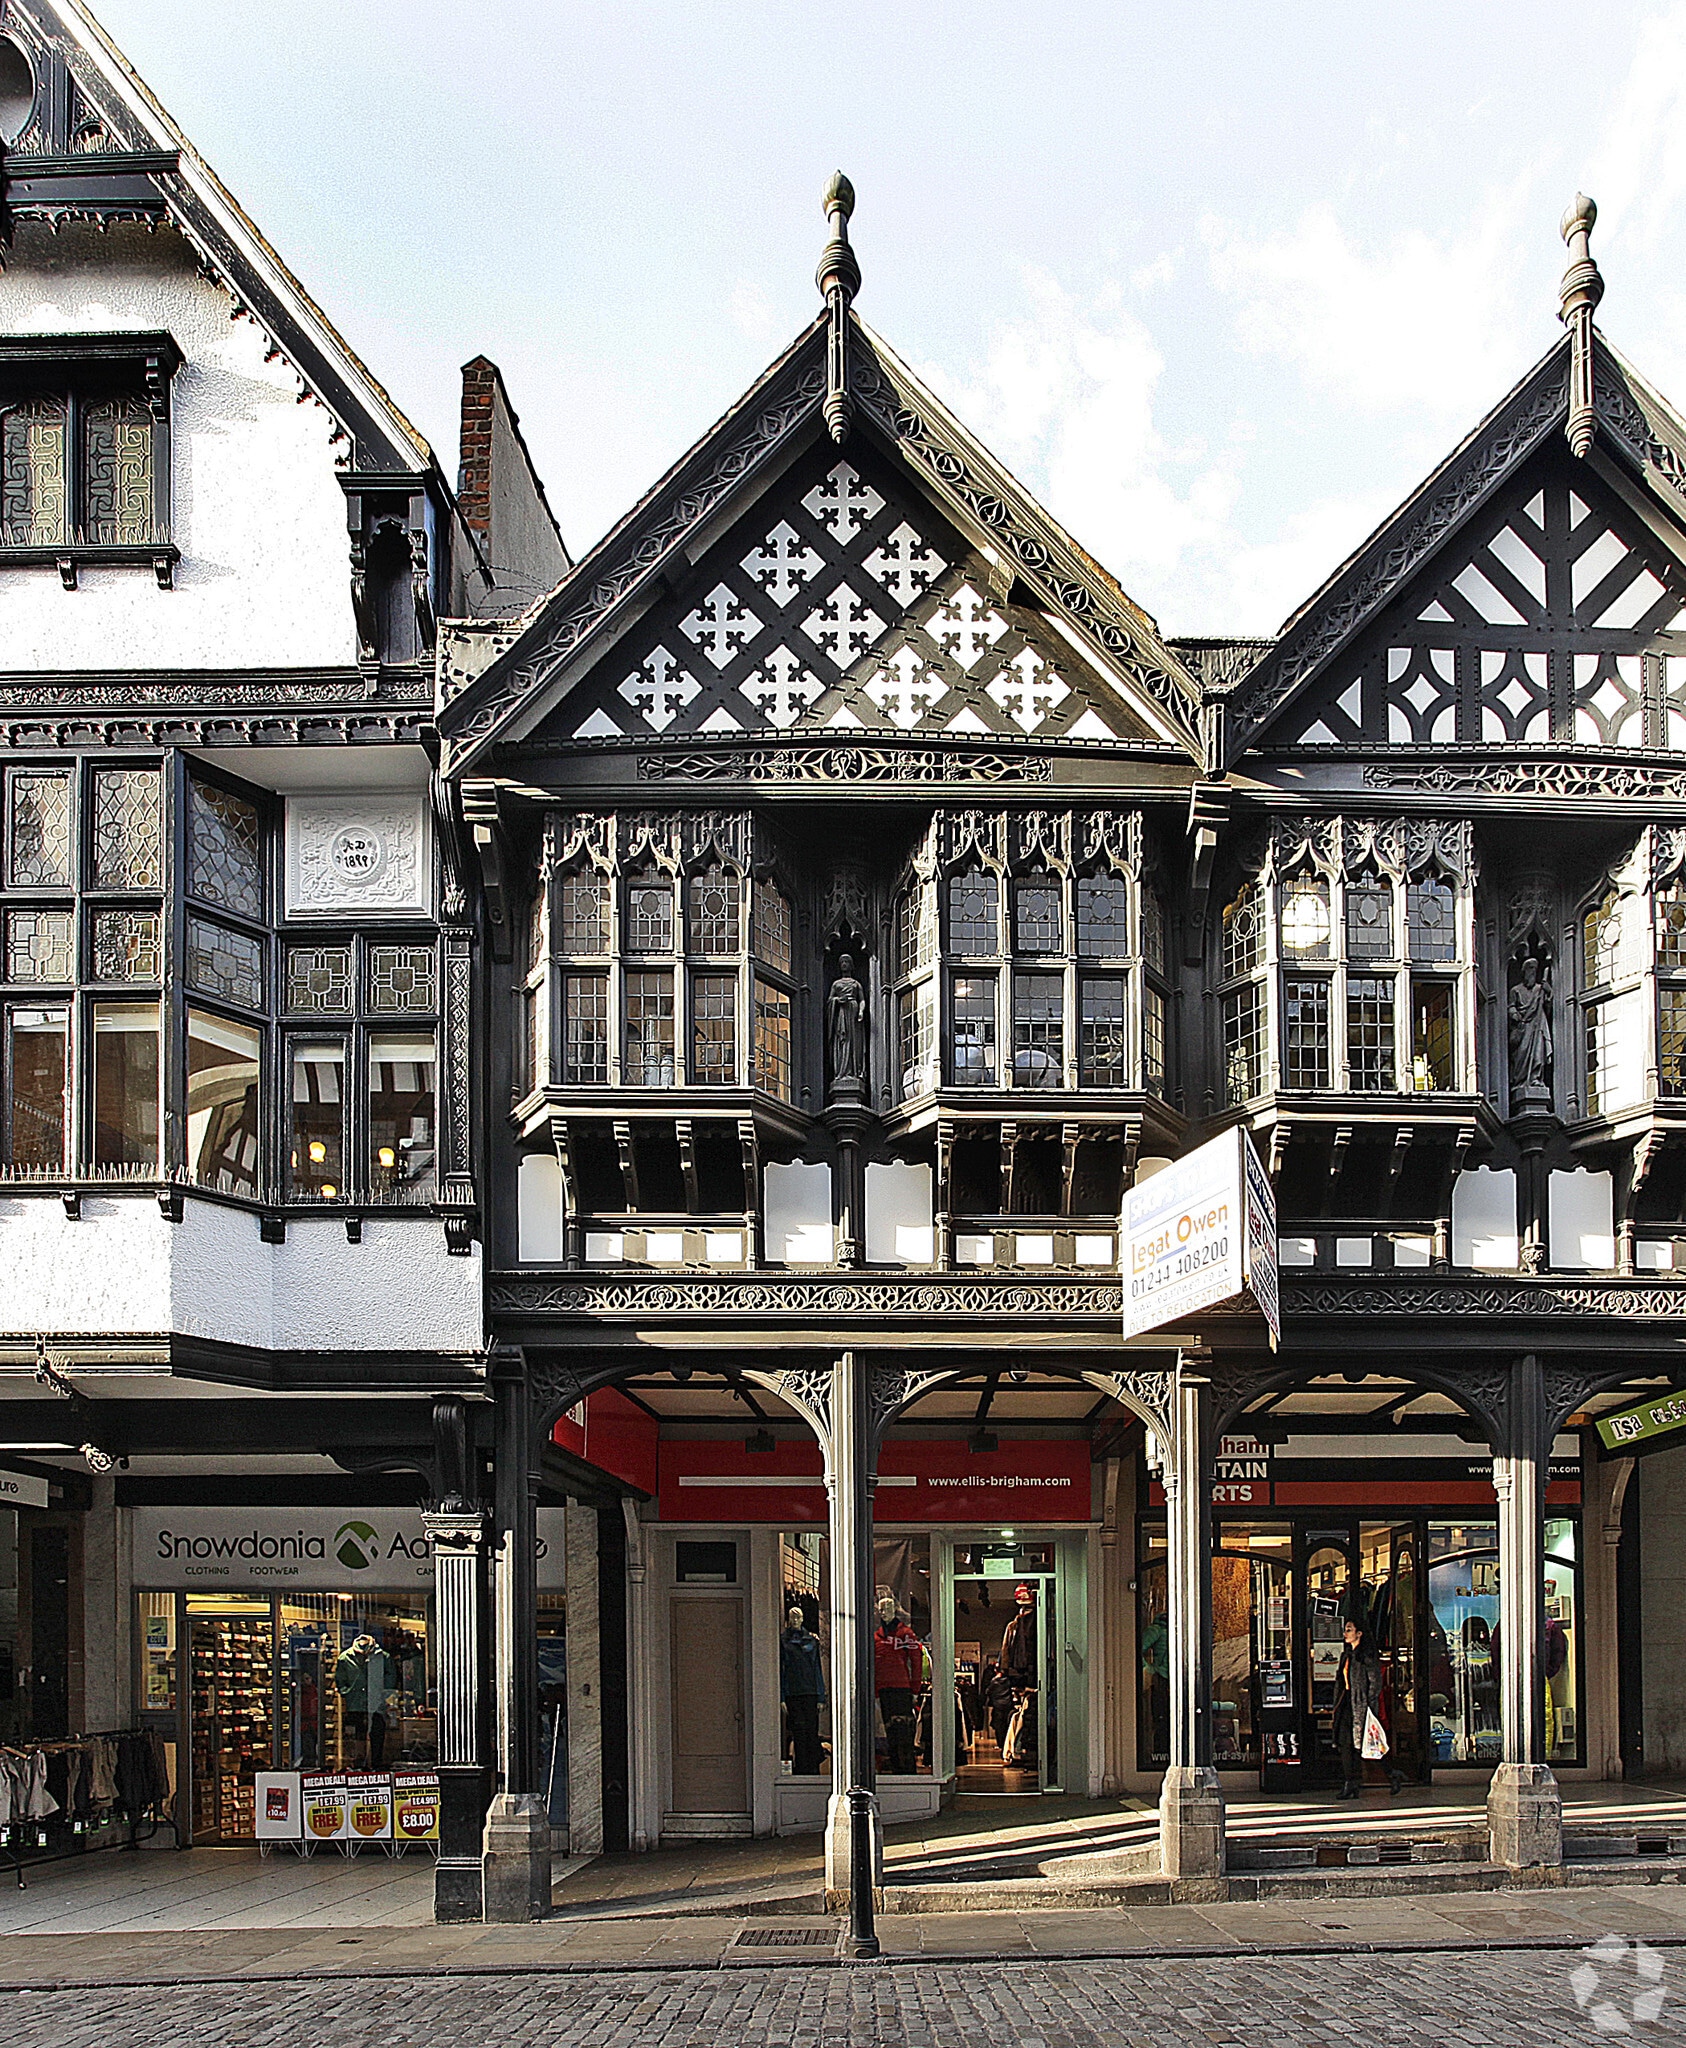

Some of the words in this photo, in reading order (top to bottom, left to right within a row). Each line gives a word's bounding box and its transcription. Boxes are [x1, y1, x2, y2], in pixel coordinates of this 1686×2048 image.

[344, 854, 368, 868] 1899
[1132, 1230, 1170, 1275] Legat
[1177, 1205, 1228, 1242] Owen
[1132, 1265, 1170, 1298] 01244
[1176, 1237, 1228, 1276] 408200
[1130, 1315, 1148, 1333] DUE
[1151, 1310, 1164, 1322] TO
[1166, 1282, 1232, 1317] RELOCATION
[928, 1475, 1071, 1488] www.ellis-brigham.com
[157, 1530, 326, 1559] Snowdonia
[185, 1567, 230, 1575] CLOTHING
[249, 1566, 299, 1575] FOOTWEAR
[303, 1776, 324, 1788] MEGA
[347, 1775, 368, 1786] MEGA
[395, 1776, 417, 1787] MEGA
[313, 1813, 338, 1828] FREE
[356, 1812, 382, 1827] FREE
[402, 1813, 433, 1828] £8.00
